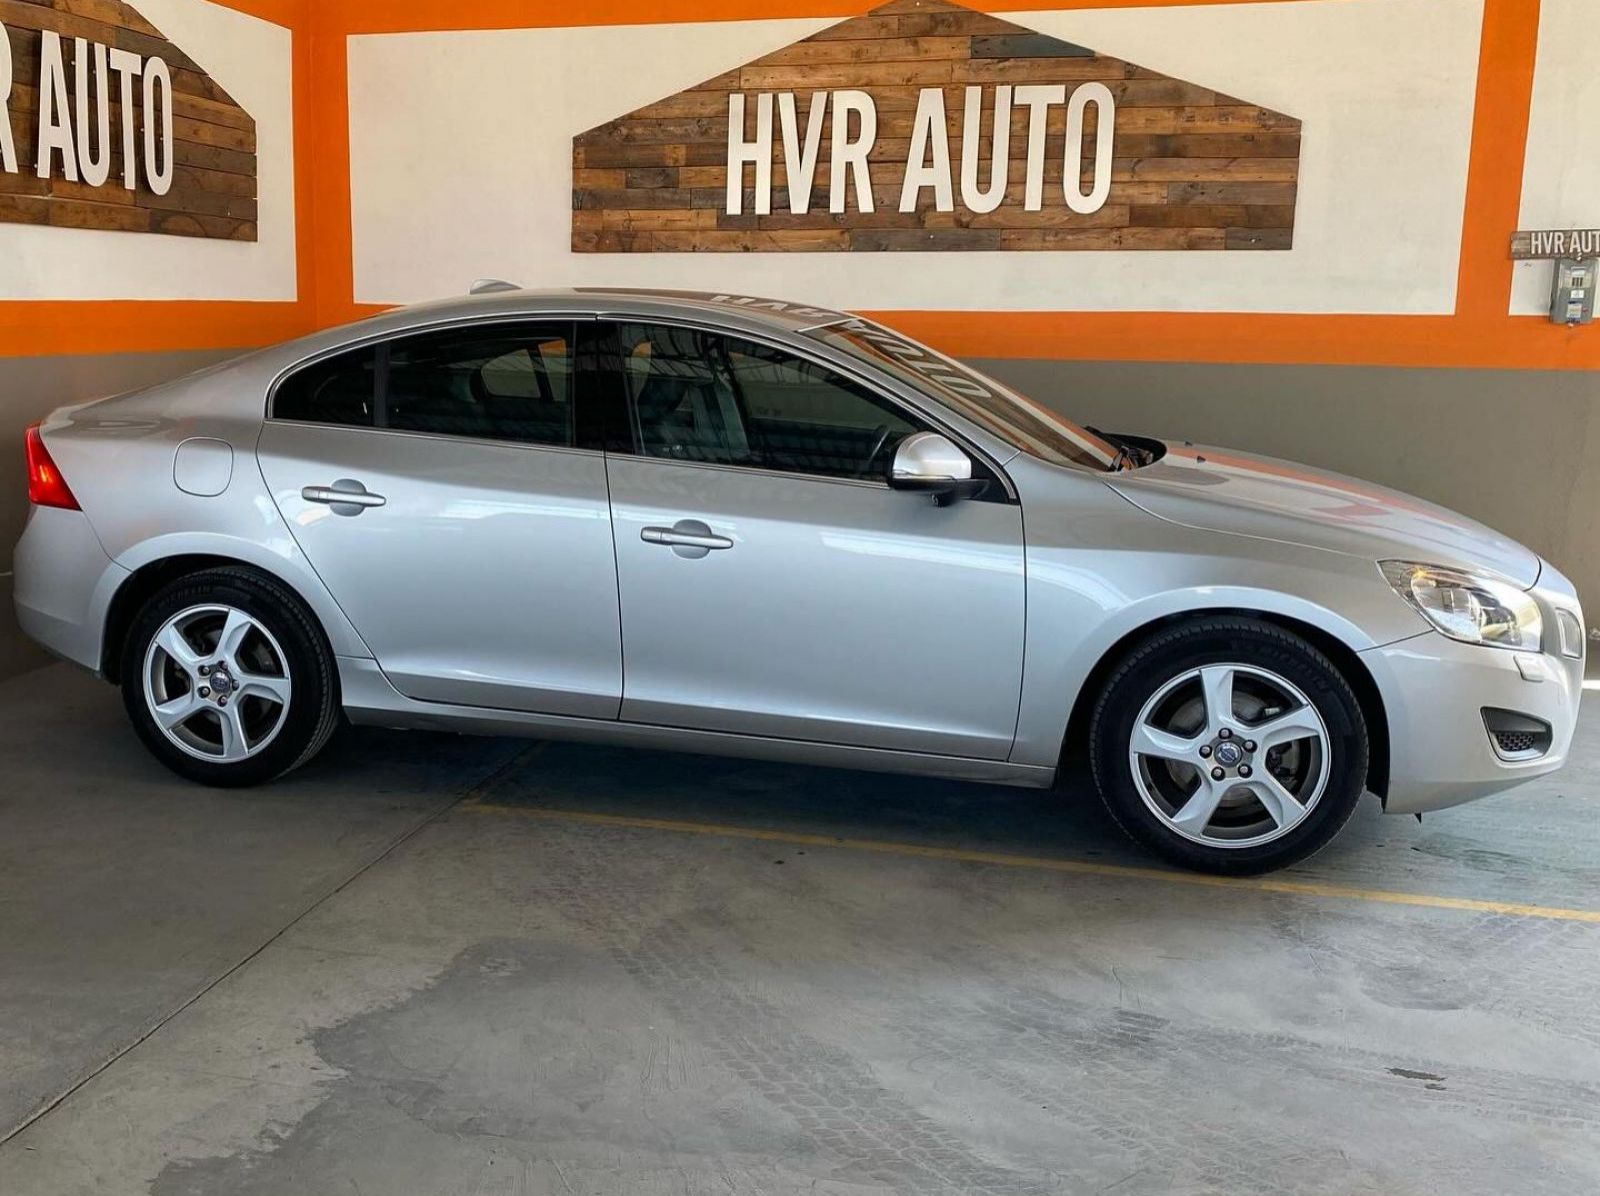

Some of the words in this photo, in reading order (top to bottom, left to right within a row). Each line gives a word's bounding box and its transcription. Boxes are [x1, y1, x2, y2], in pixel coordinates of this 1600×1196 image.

[37, 30, 173, 196] AUTO
[726, 91, 876, 215] HVR
[898, 82, 1115, 214] AUTO
[1531, 232, 1564, 254] HVR
